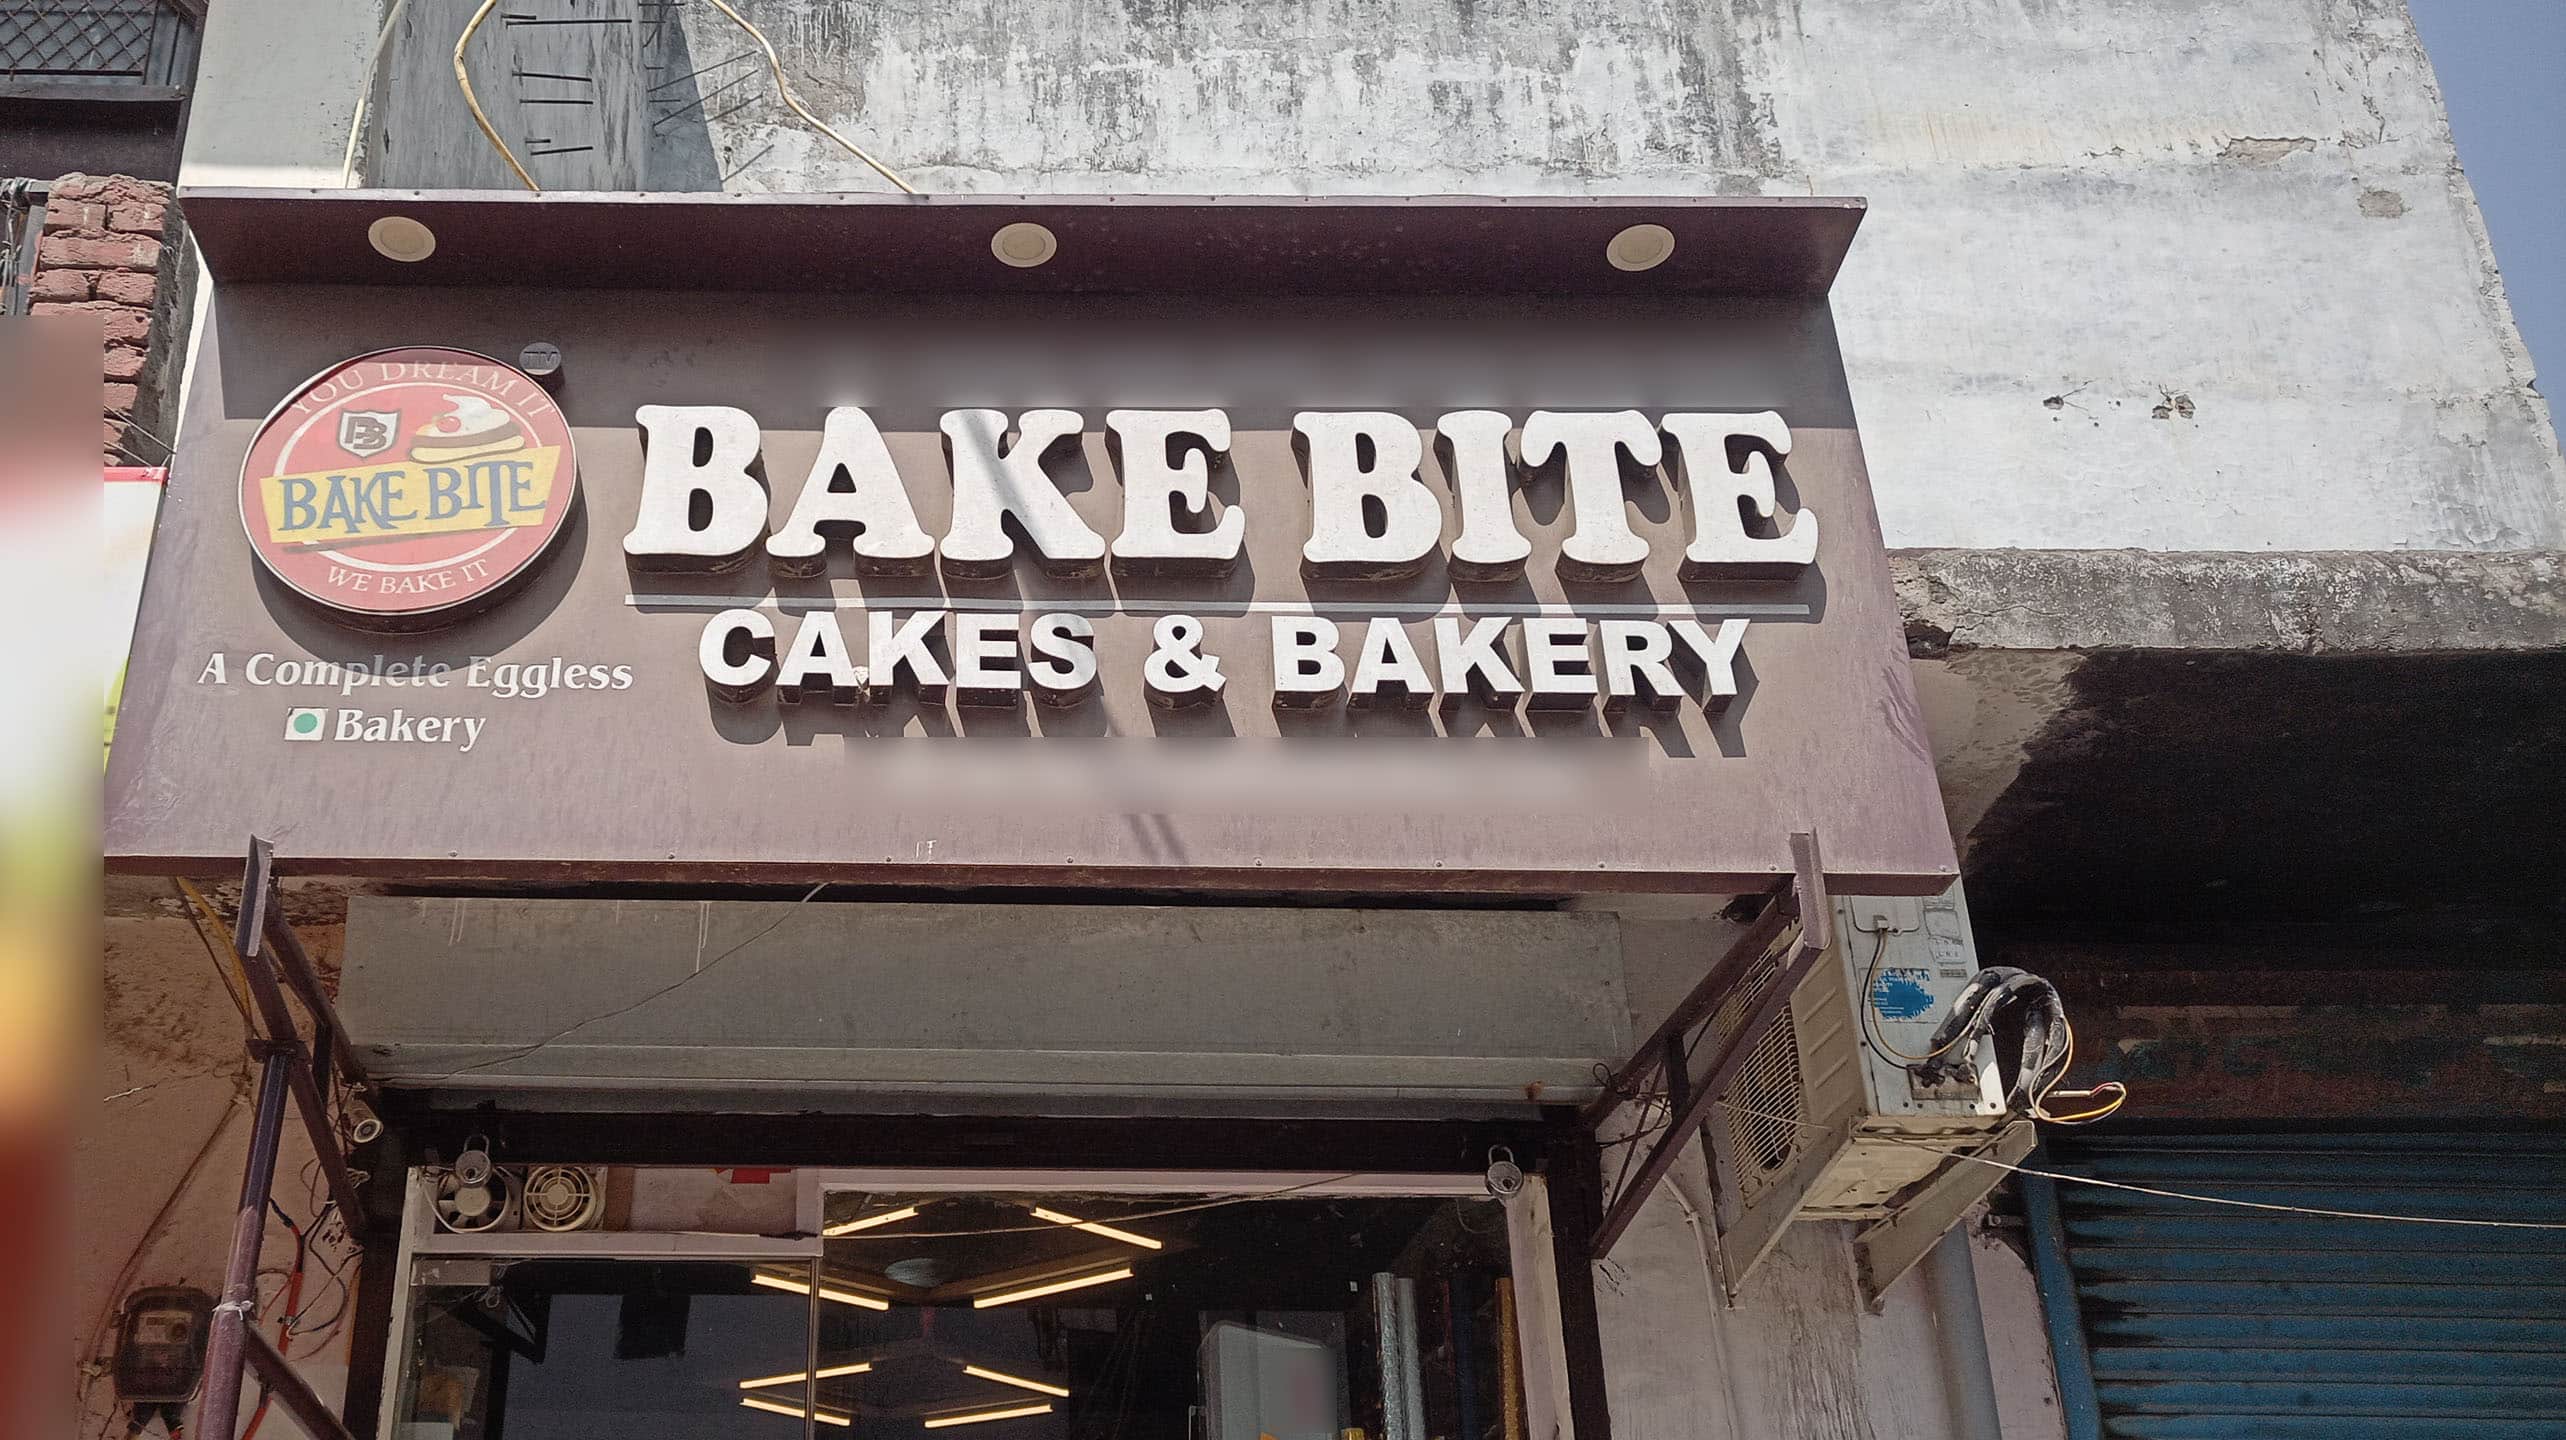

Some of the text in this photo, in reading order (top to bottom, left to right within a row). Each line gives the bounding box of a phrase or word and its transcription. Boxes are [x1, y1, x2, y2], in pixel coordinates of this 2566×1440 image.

[290, 361, 556, 418] YOU DREAM IT
[277, 460, 546, 534] BAKE BITE
[622, 404, 1819, 565] BAKE BITE
[327, 559, 488, 595] WE BAKE IT
[198, 652, 635, 699] A Complete Eggless
[699, 608, 1751, 697] CAKES & BAKERY
[334, 709, 488, 752] Bakery
